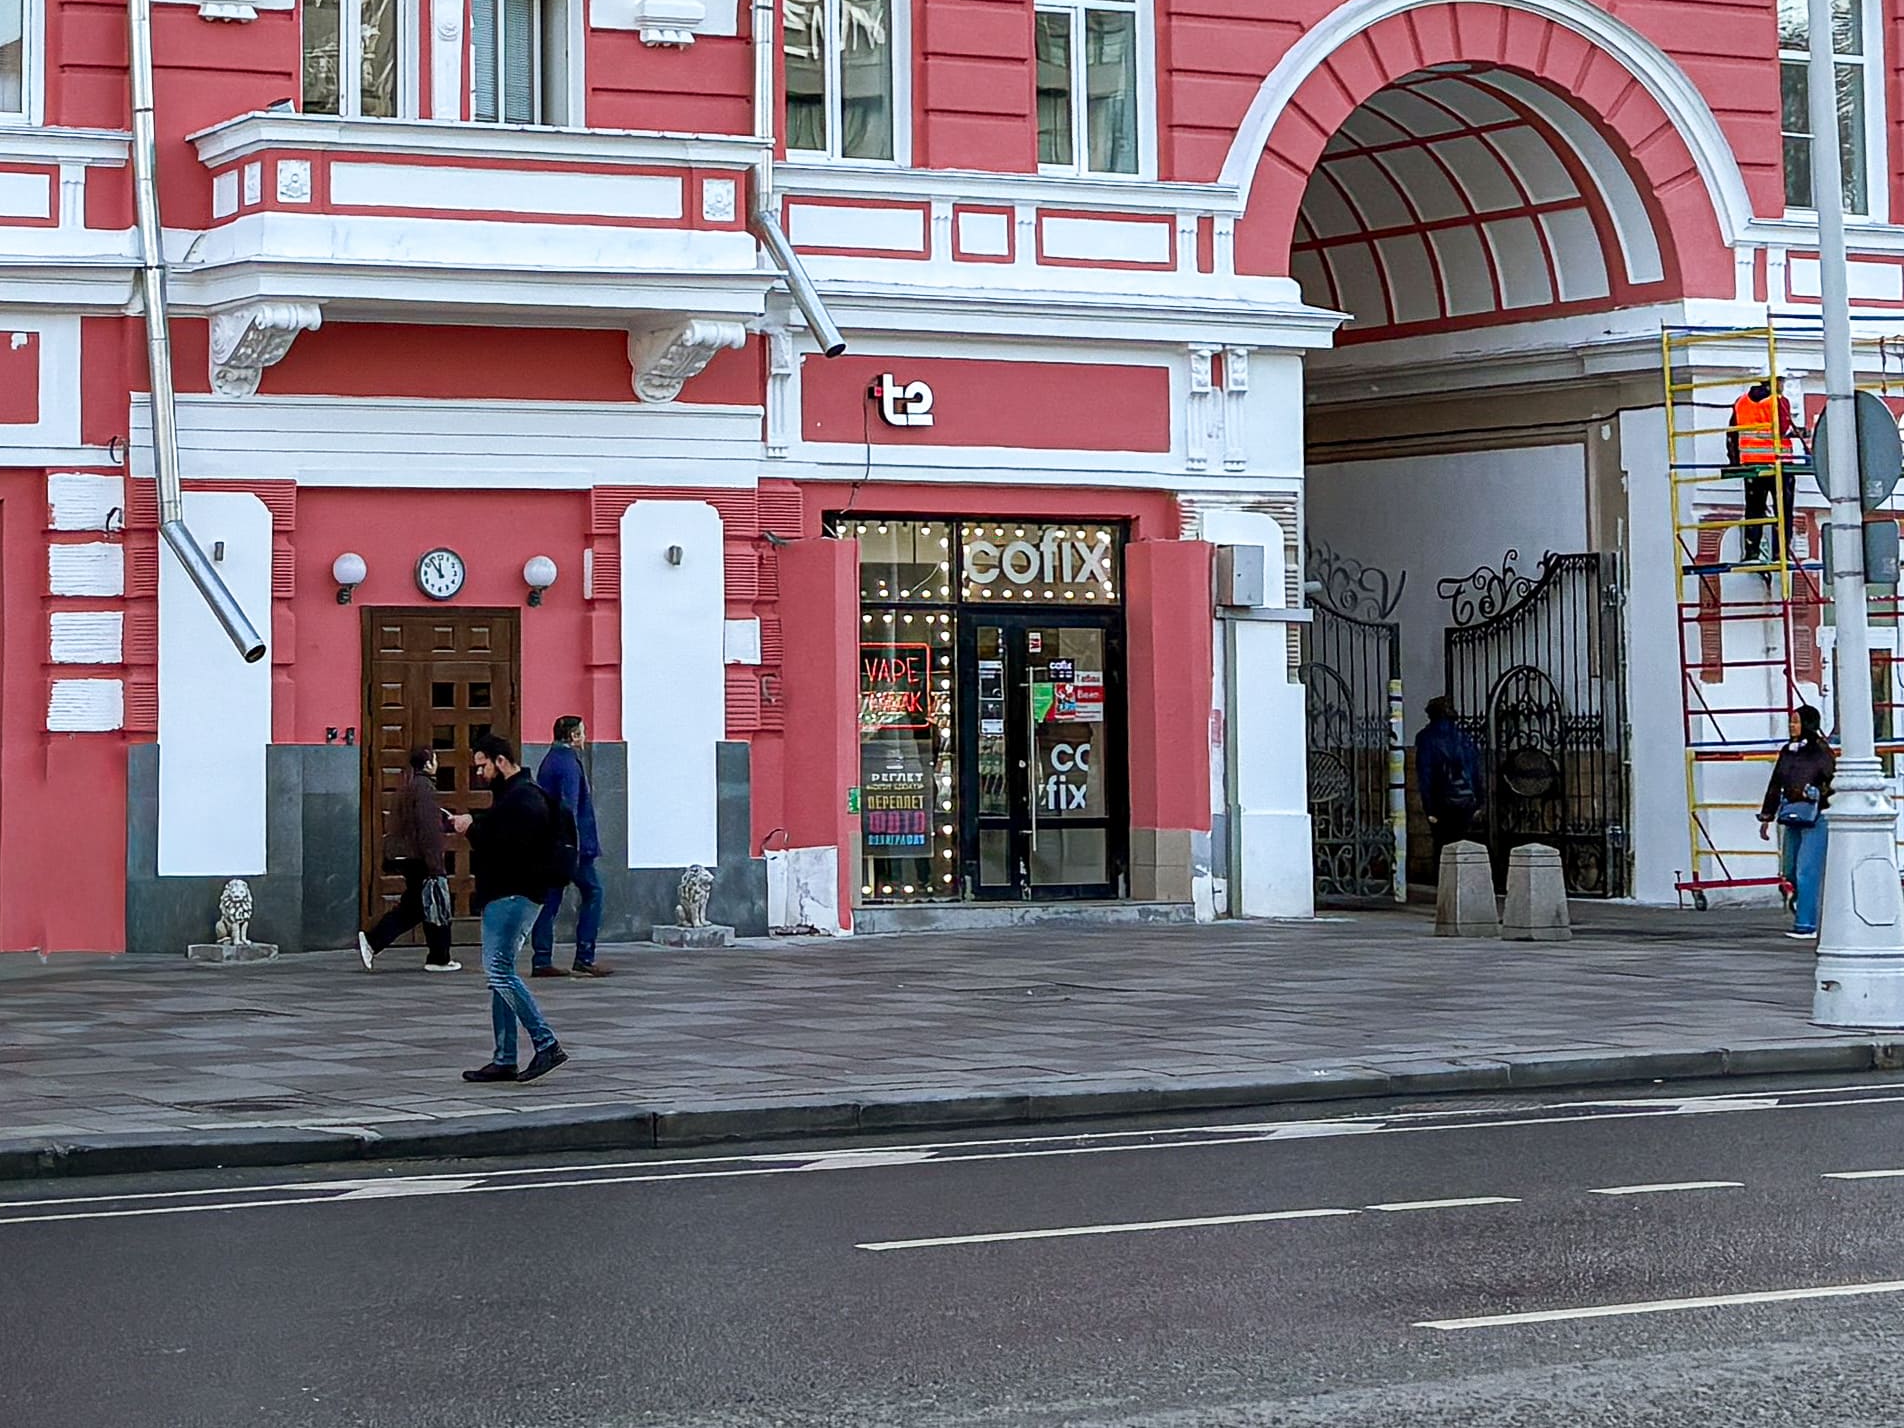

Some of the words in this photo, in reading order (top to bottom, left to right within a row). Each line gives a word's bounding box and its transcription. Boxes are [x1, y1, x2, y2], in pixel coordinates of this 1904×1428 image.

[881, 373, 934, 426] t2
[964, 528, 1107, 584] cofix
[865, 657, 920, 683] VAPE
[1046, 775, 1087, 810] fix
